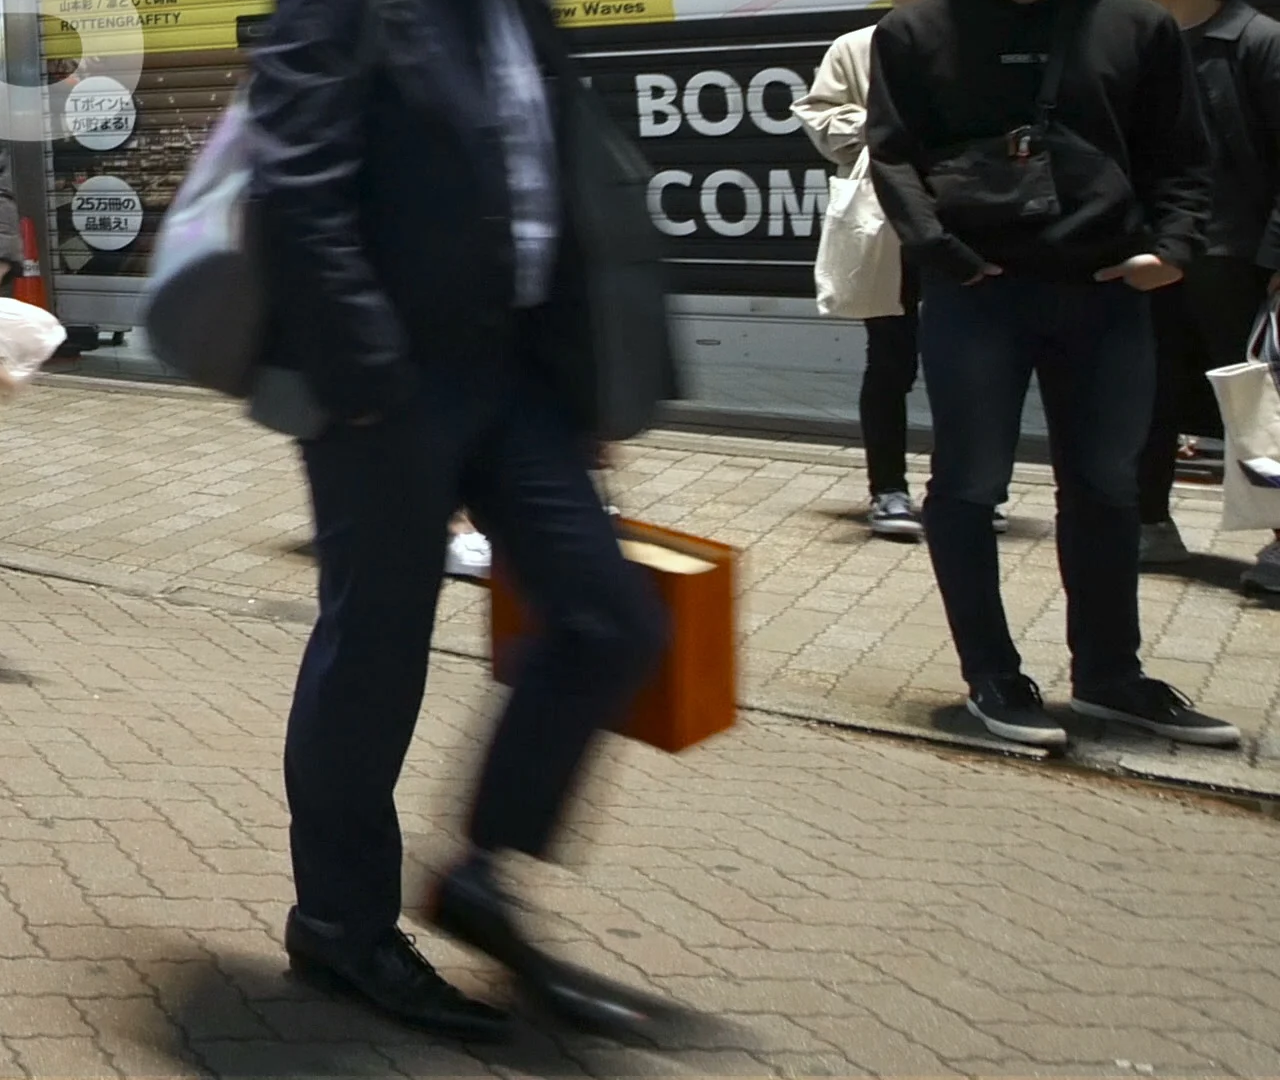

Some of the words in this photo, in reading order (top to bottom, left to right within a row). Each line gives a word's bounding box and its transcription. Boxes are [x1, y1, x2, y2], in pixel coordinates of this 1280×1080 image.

[583, 0, 646, 18] Waves
[60, 11, 182, 32] ROTTENGRAFFTY
[76, 197, 136, 212] 25万冊の
